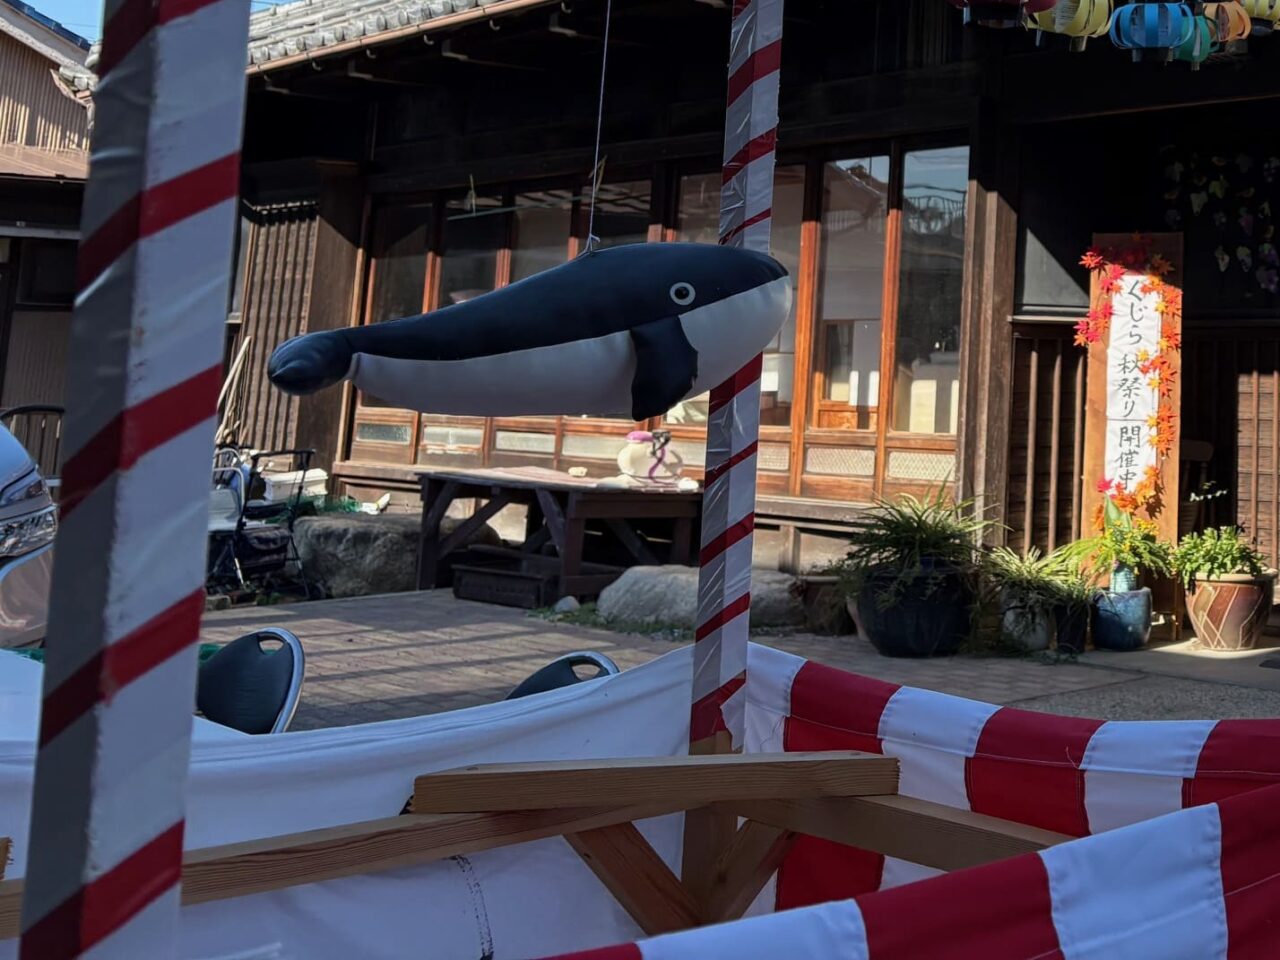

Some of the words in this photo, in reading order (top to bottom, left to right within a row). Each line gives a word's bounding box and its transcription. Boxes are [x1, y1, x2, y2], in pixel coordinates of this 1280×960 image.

[1127, 279, 1148, 346] くじら
[1116, 353, 1142, 418] 秋祭り
[1115, 425, 1141, 490] 開催中
